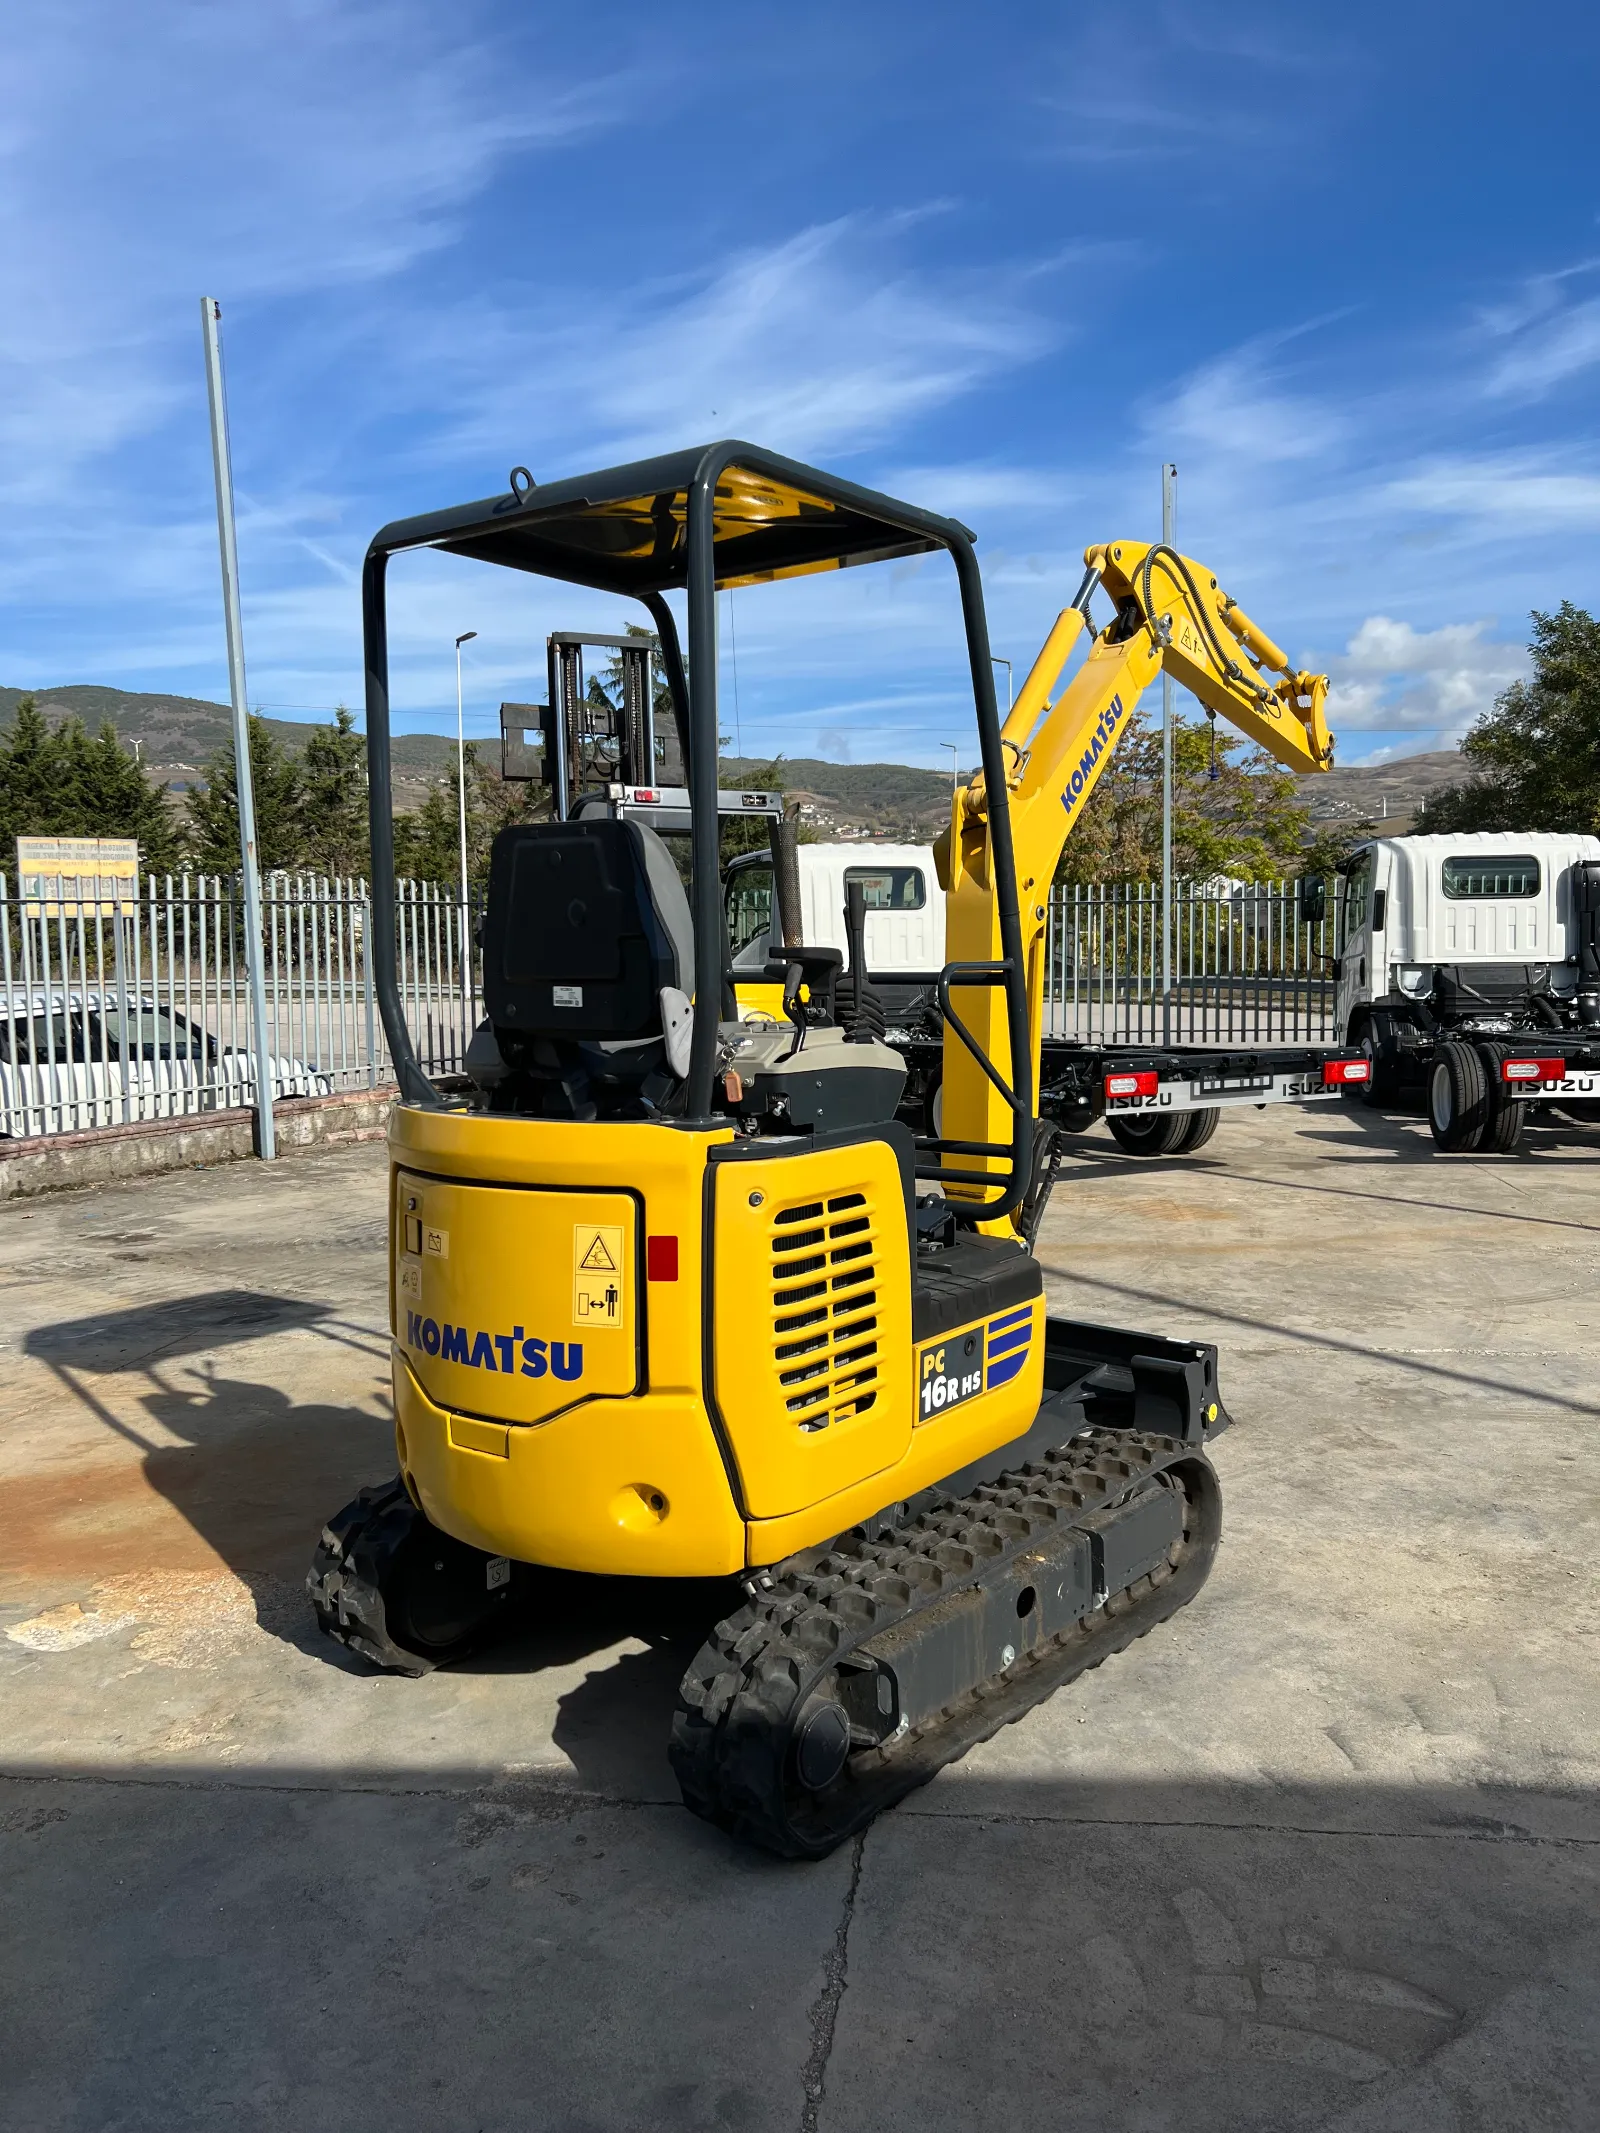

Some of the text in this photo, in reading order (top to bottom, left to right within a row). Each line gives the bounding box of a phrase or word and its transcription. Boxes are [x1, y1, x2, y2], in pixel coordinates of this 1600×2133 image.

[1060, 693, 1124, 814] KOMATSU
[1282, 1082, 1338, 1097] ISUZU
[1517, 1079, 1594, 1092] ISUZU
[1110, 1092, 1172, 1109] ISUZU
[407, 1310, 584, 1382] KOMATSU
[923, 1348, 945, 1380] PC
[961, 1370, 981, 1396] HS
